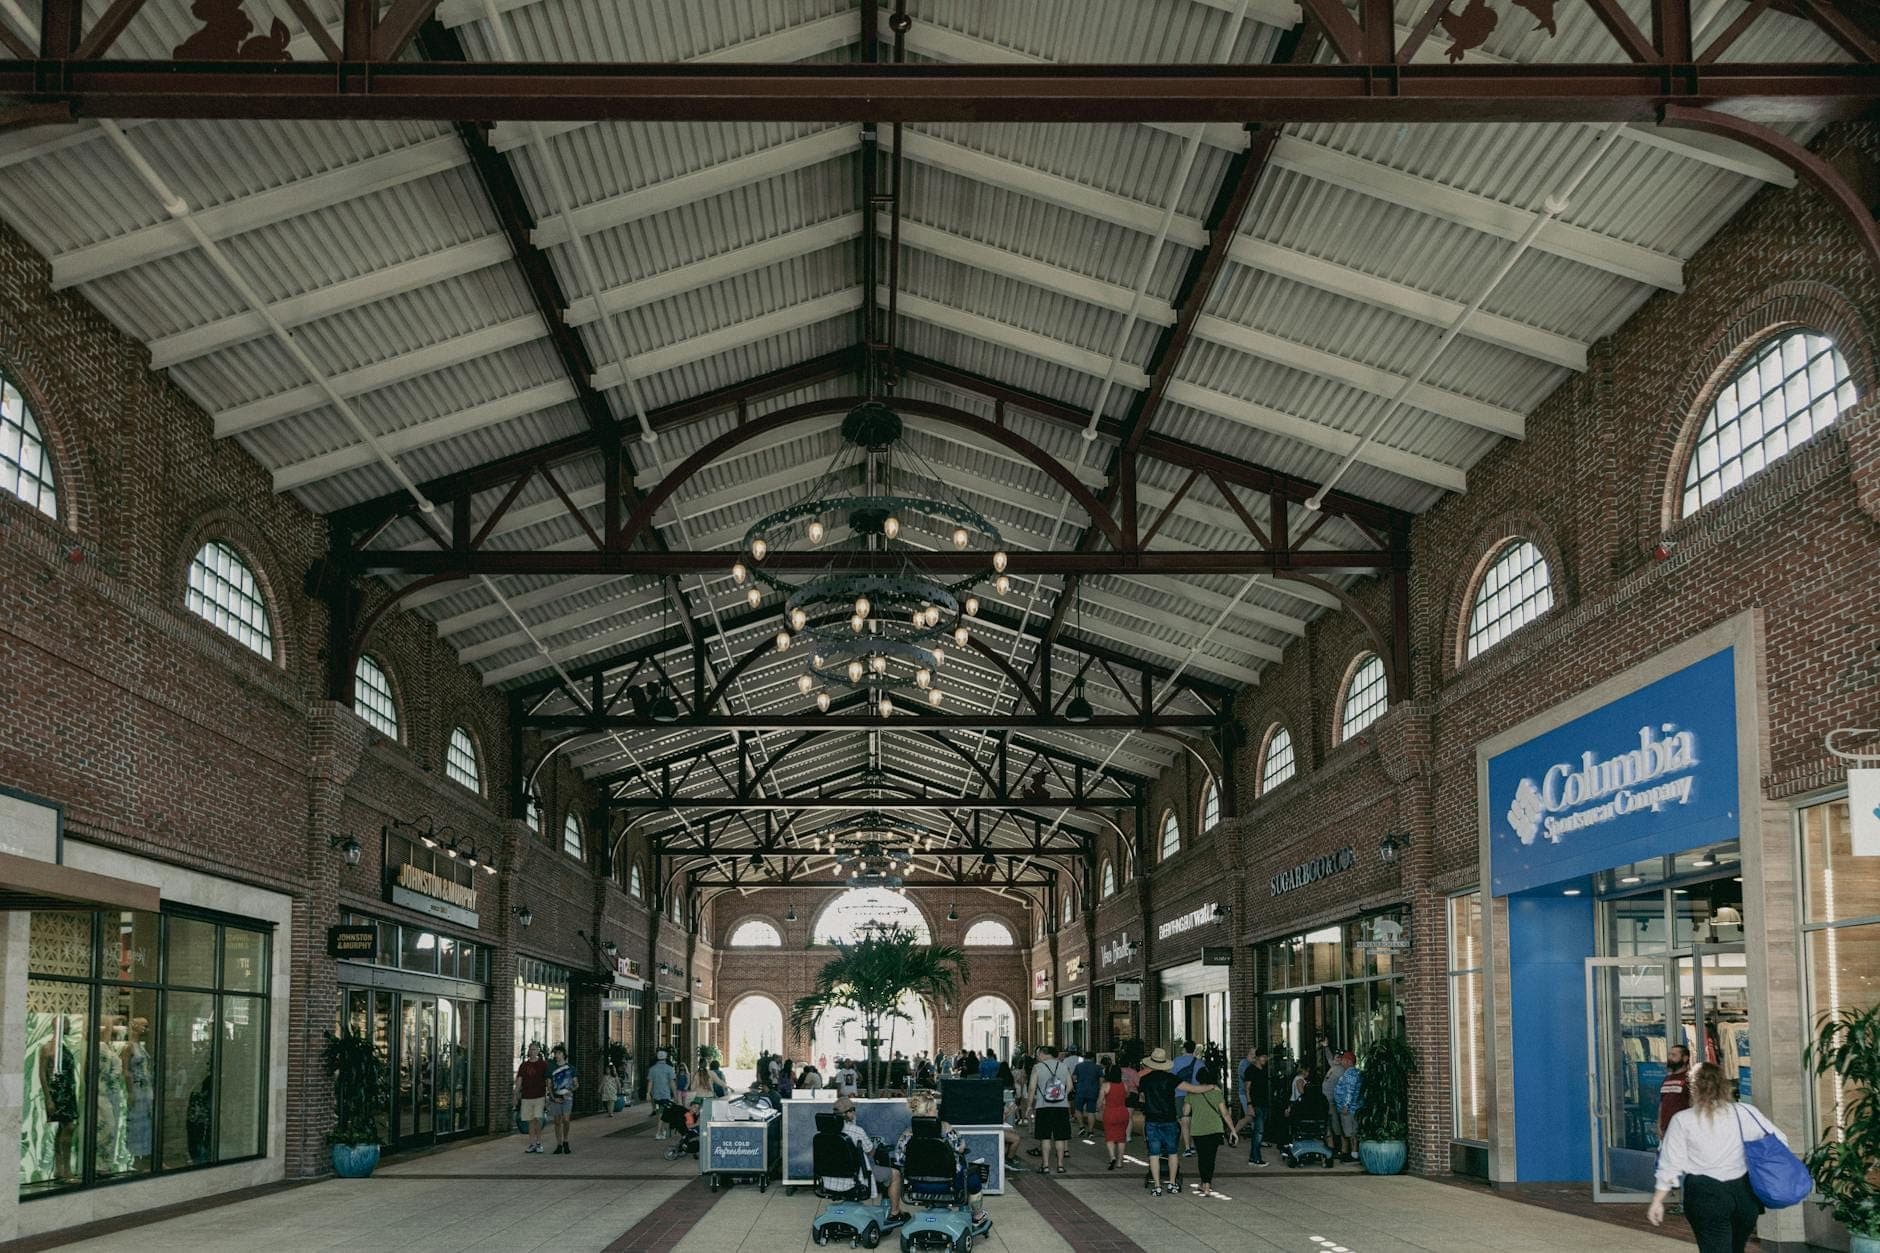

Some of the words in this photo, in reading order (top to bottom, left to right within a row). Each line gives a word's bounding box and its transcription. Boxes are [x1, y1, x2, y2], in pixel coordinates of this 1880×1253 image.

[1543, 723, 1697, 812] Columbia
[1544, 801, 1615, 843] Sportswear
[1614, 776, 1694, 815] Company
[337, 933, 373, 942] JOHNSTON
[714, 1146, 759, 1158] Refreshment
